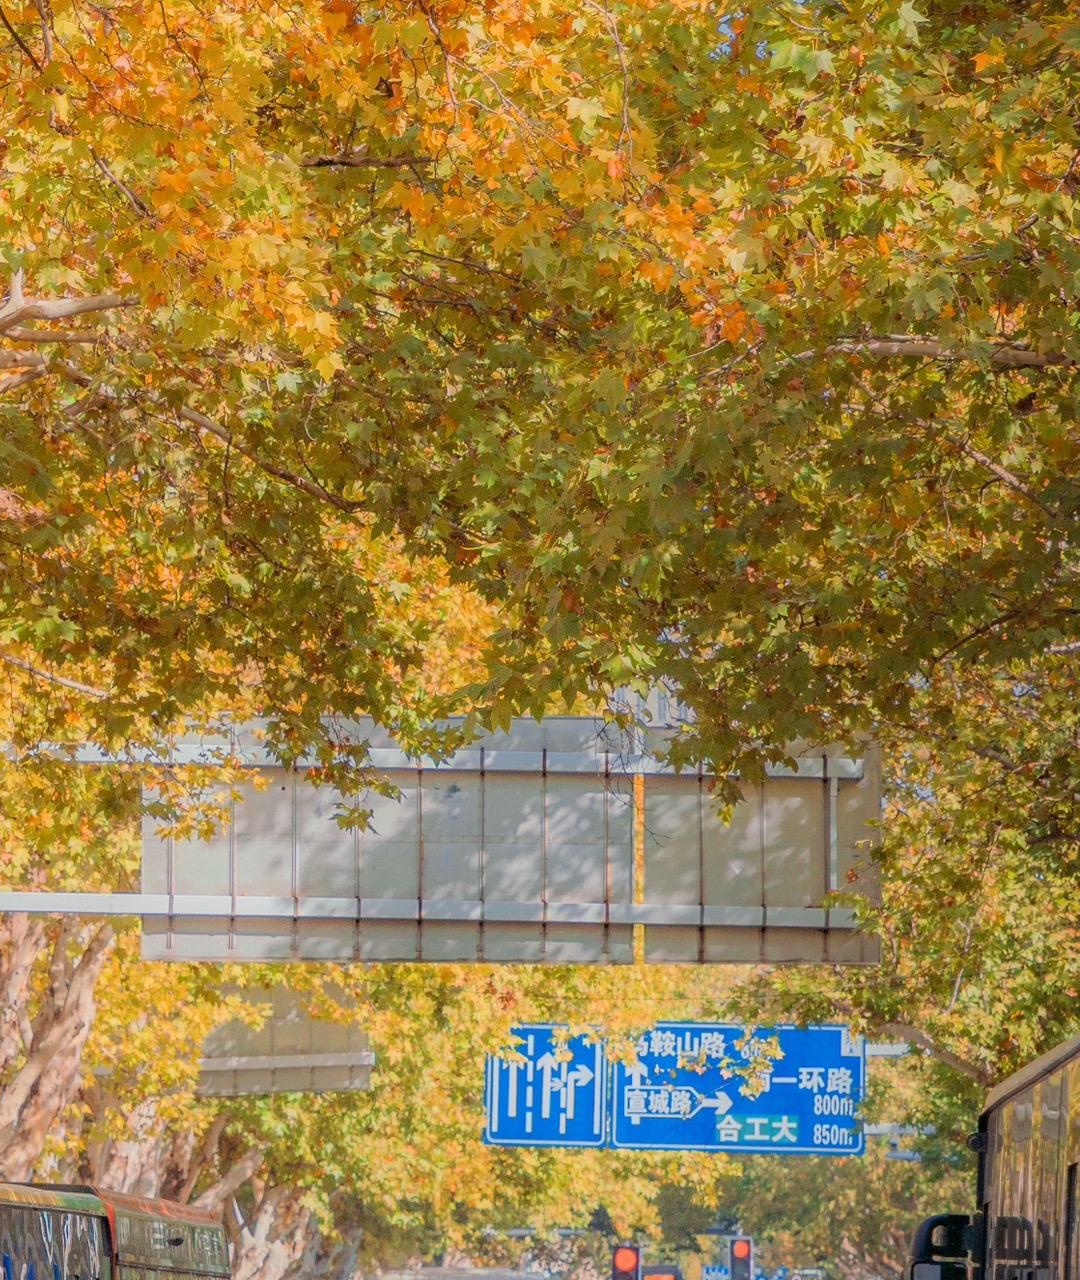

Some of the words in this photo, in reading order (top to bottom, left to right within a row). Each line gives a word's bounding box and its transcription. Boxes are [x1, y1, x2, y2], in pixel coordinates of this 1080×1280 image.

[627, 1090, 692, 1115] 宣城路
[813, 1094, 853, 1116] 800m
[716, 1115, 797, 1142] 合工大
